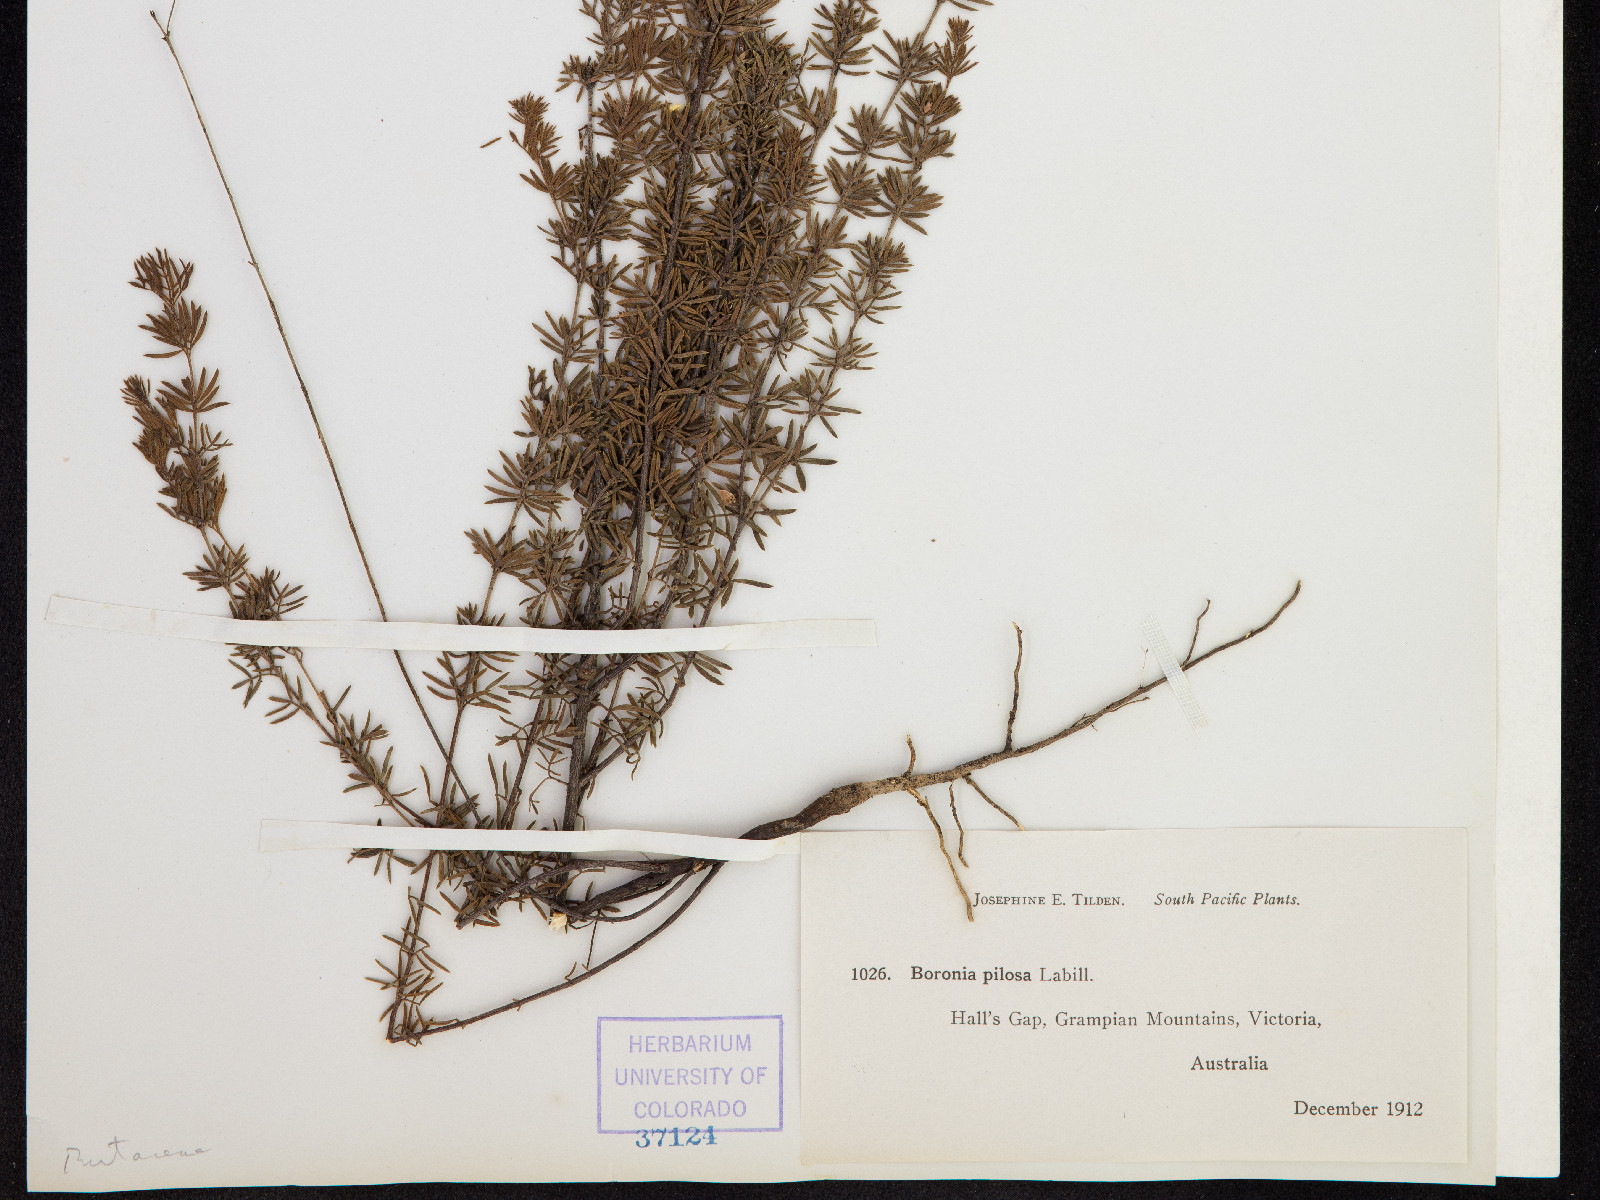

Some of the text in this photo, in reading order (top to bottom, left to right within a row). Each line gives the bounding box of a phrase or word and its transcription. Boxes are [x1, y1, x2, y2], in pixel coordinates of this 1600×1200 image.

[1052, 893, 1066, 906] E.
[1154, 892, 1300, 906] South Pacific Plants.
[851, 965, 1094, 986] 1026. Boronia pilosa Labill.
[950, 1010, 1322, 1030] Hall's Gap, Grampian Mountains, Victoria,
[629, 1034, 752, 1053] HERBARIUM
[1191, 1055, 1269, 1071] Australia
[615, 1067, 768, 1086] UNIVERSITY OF
[634, 1100, 747, 1119] COLORADO
[1294, 1100, 1424, 1117] December 1912
[635, 1125, 718, 1148] 37124
